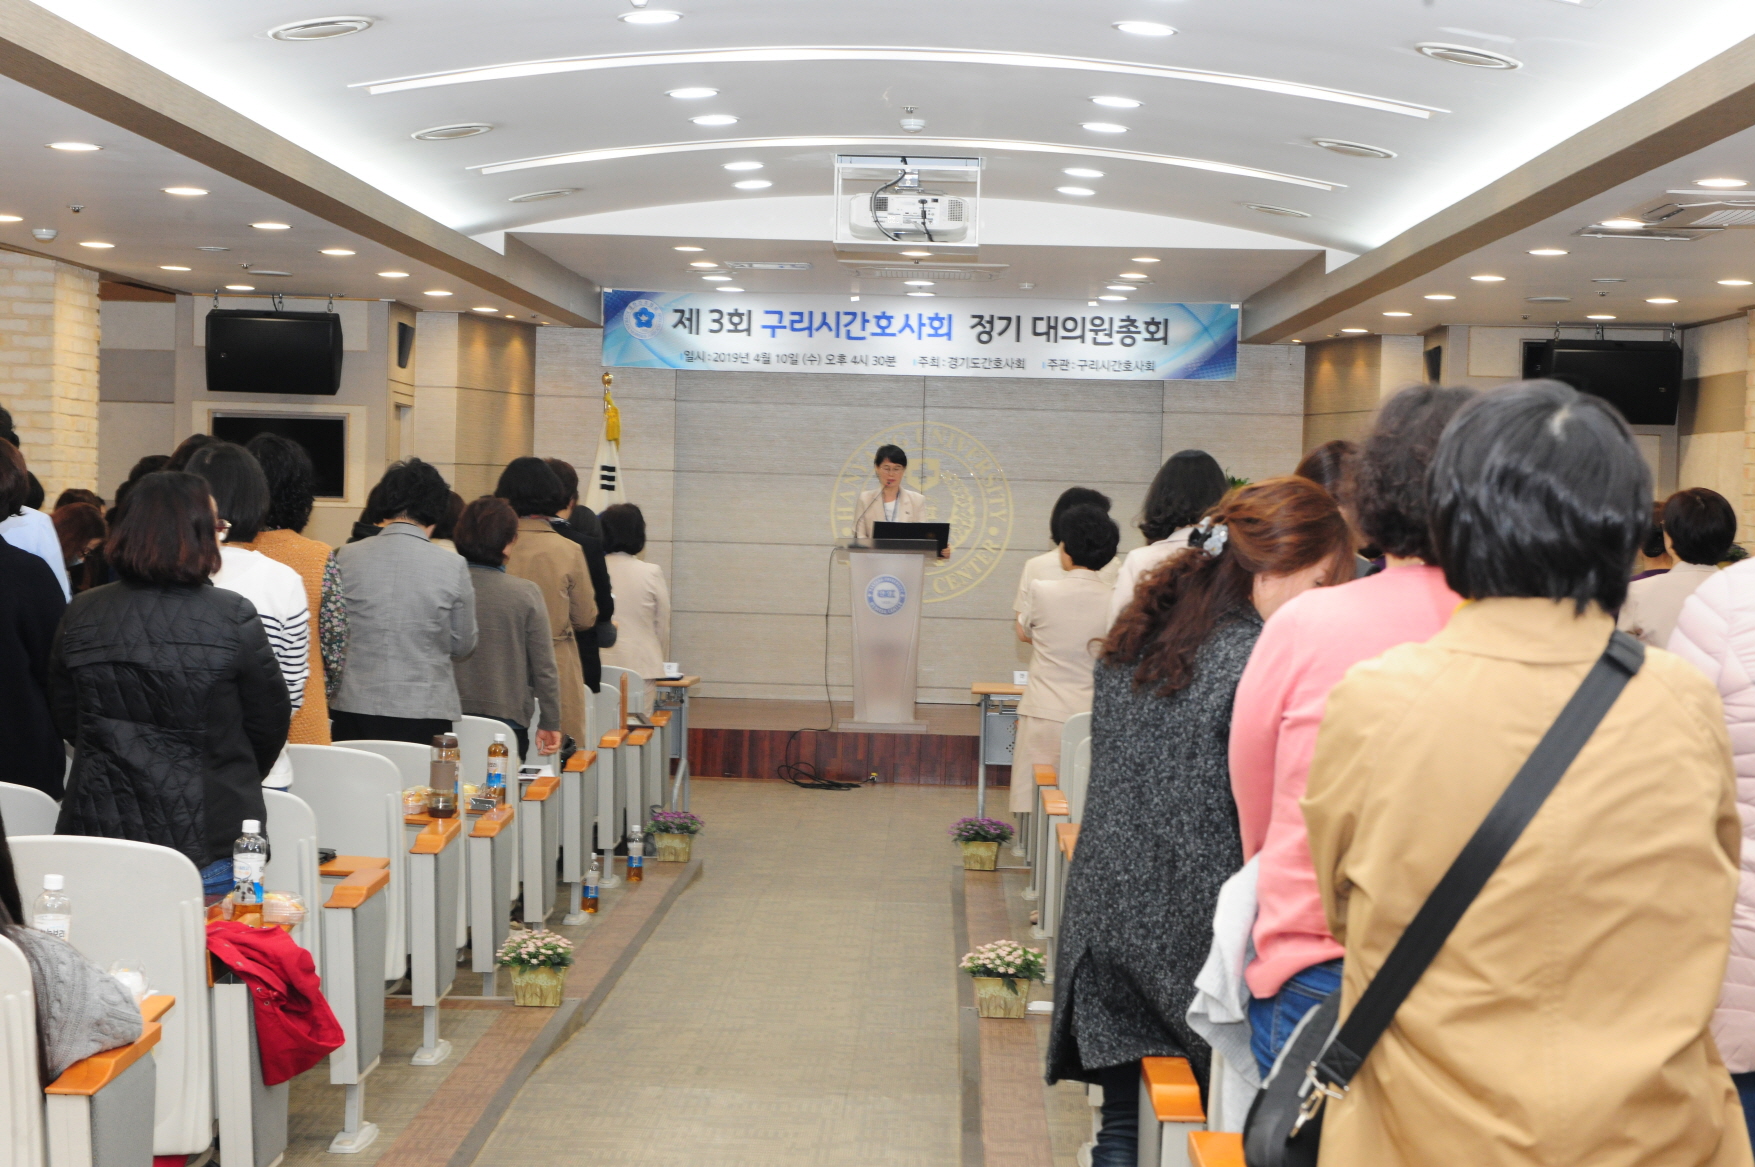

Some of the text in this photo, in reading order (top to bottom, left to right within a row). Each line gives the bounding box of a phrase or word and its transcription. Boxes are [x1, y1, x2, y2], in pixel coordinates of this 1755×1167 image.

[672, 308, 700, 335] 제
[708, 308, 752, 336] 3회
[760, 310, 952, 342] 구리시간호사회
[969, 313, 1021, 344] 정기
[1031, 314, 1169, 347] 대의원총회
[753, 352, 771, 365] 4월
[775, 353, 799, 366] 10일
[802, 353, 822, 366] (수)
[825, 354, 848, 366] 오후
[851, 355, 868, 367] 4시
[872, 356, 897, 368] 30분
[915, 427, 1007, 522] UNIVERSITY
[933, 539, 1000, 594] CENTER
